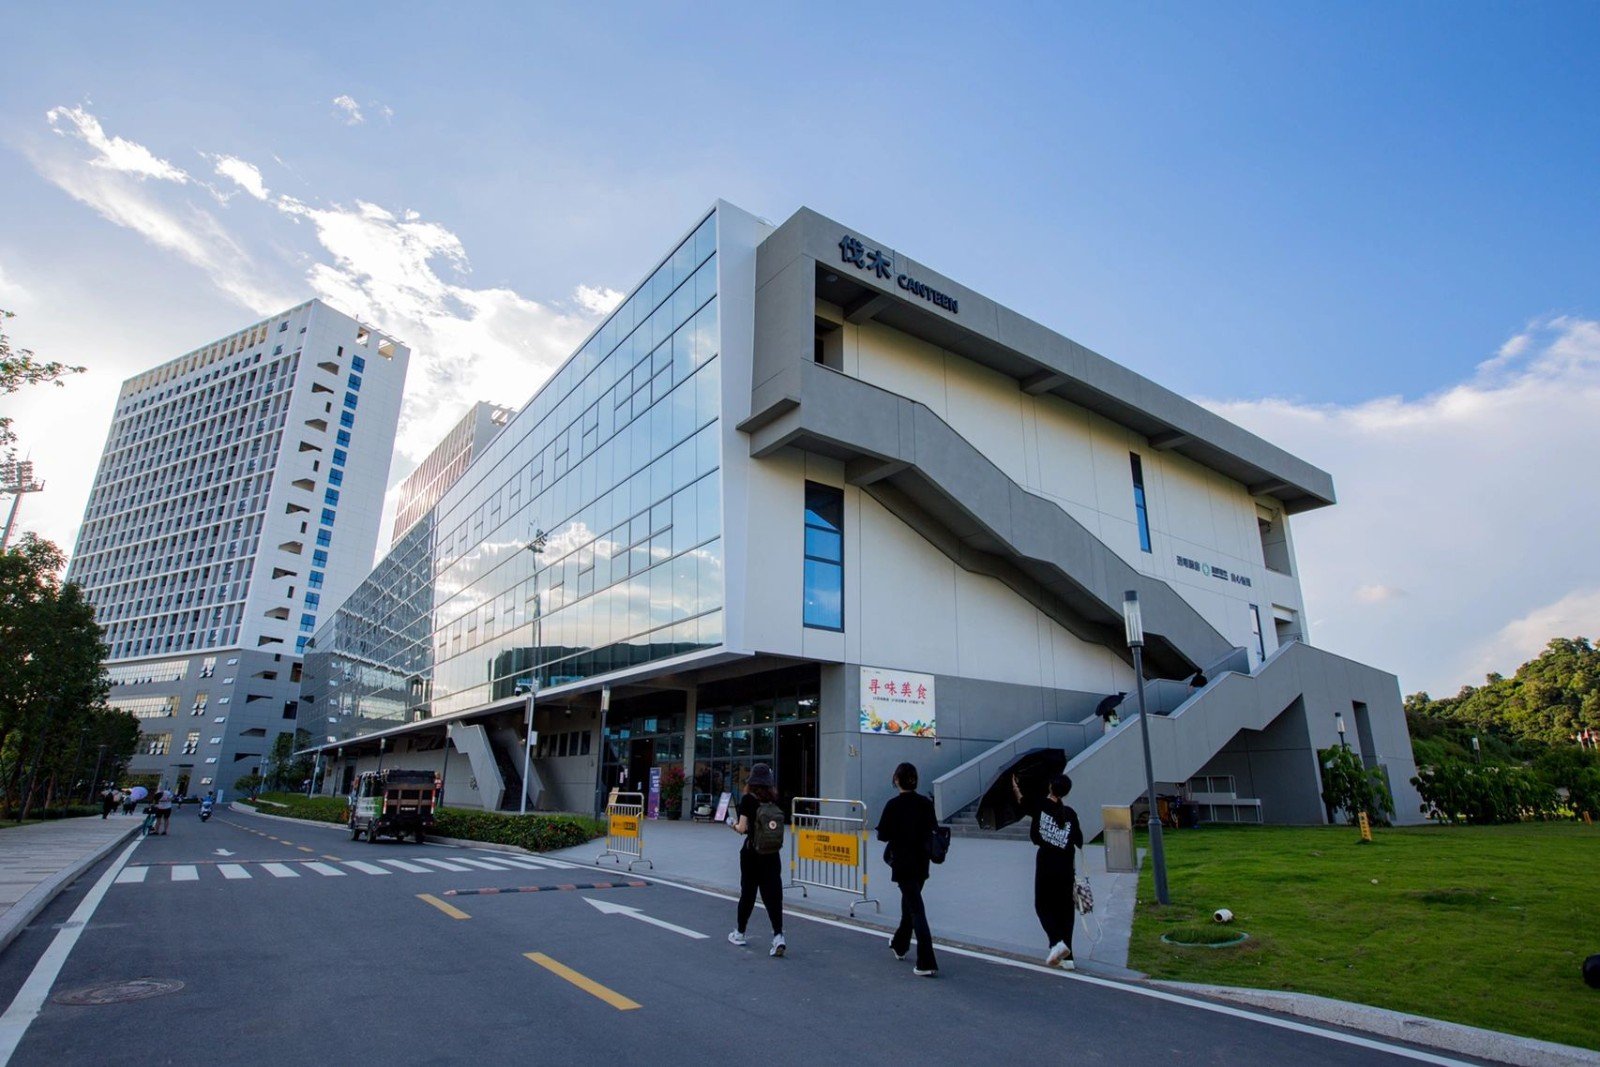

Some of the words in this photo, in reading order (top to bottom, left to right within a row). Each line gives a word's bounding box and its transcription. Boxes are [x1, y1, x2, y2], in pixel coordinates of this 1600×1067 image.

[838, 234, 892, 279] 伐木
[897, 274, 959, 314] CANTEEN
[868, 678, 928, 700] 寻味美食
